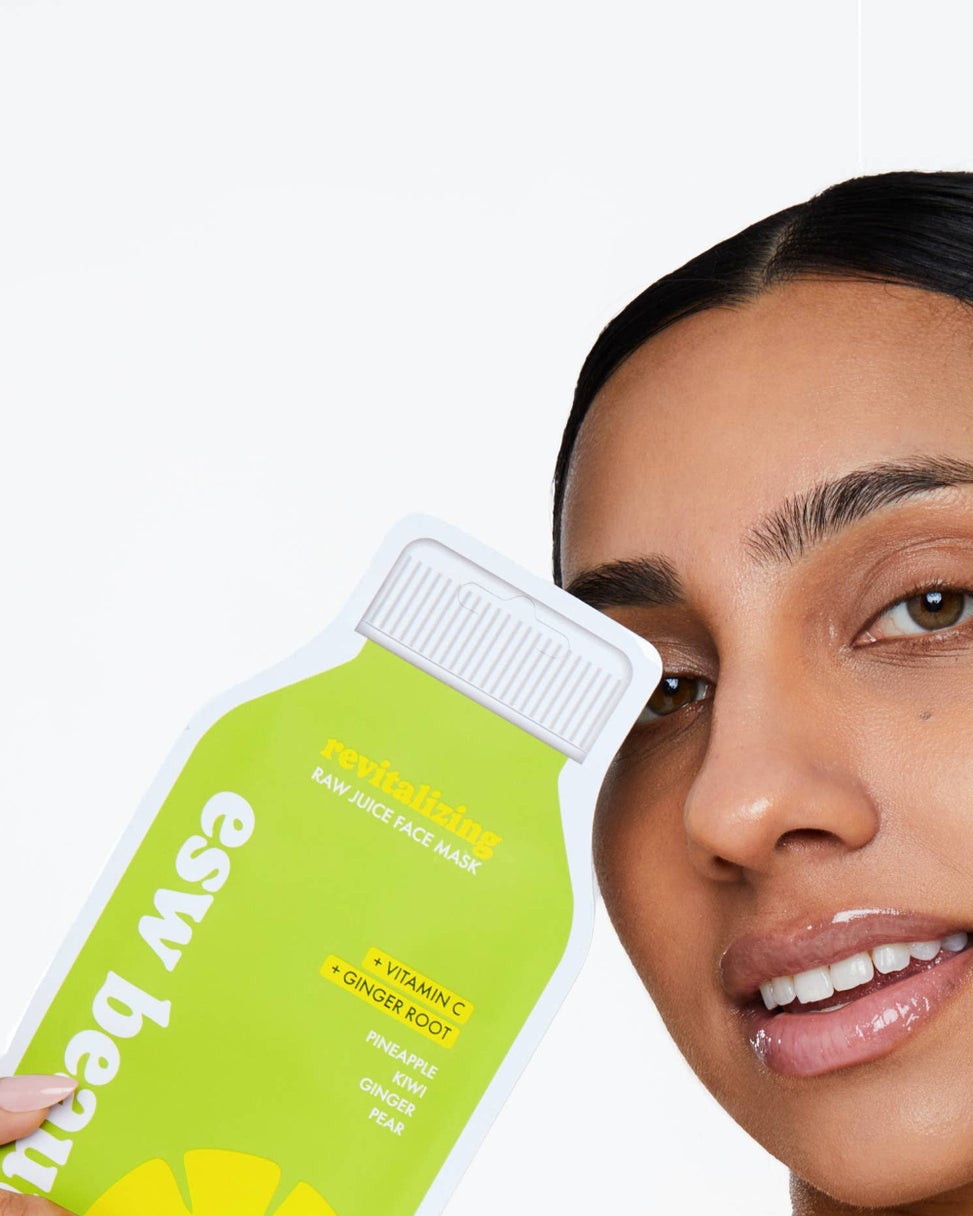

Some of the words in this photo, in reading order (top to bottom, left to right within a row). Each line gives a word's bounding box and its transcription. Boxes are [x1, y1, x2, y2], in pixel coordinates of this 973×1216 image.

[311, 766, 352, 796] RAW
[347, 790, 395, 824] JUICE
[393, 815, 435, 848] FACE
[433, 840, 482, 876] MASK
[320, 738, 503, 860] revitalizing
[138, 791, 255, 972] esw
[343, 971, 404, 1015] GINGER
[404, 1006, 453, 1040] ROOT
[386, 961, 452, 1008] VITAMIN
[451, 1002, 466, 1017] C
[365, 1030, 439, 1080] PINEAPPLE
[359, 1077, 416, 1118] GINGER
[391, 1071, 428, 1099] KIWI
[368, 1107, 406, 1137] PEAR
